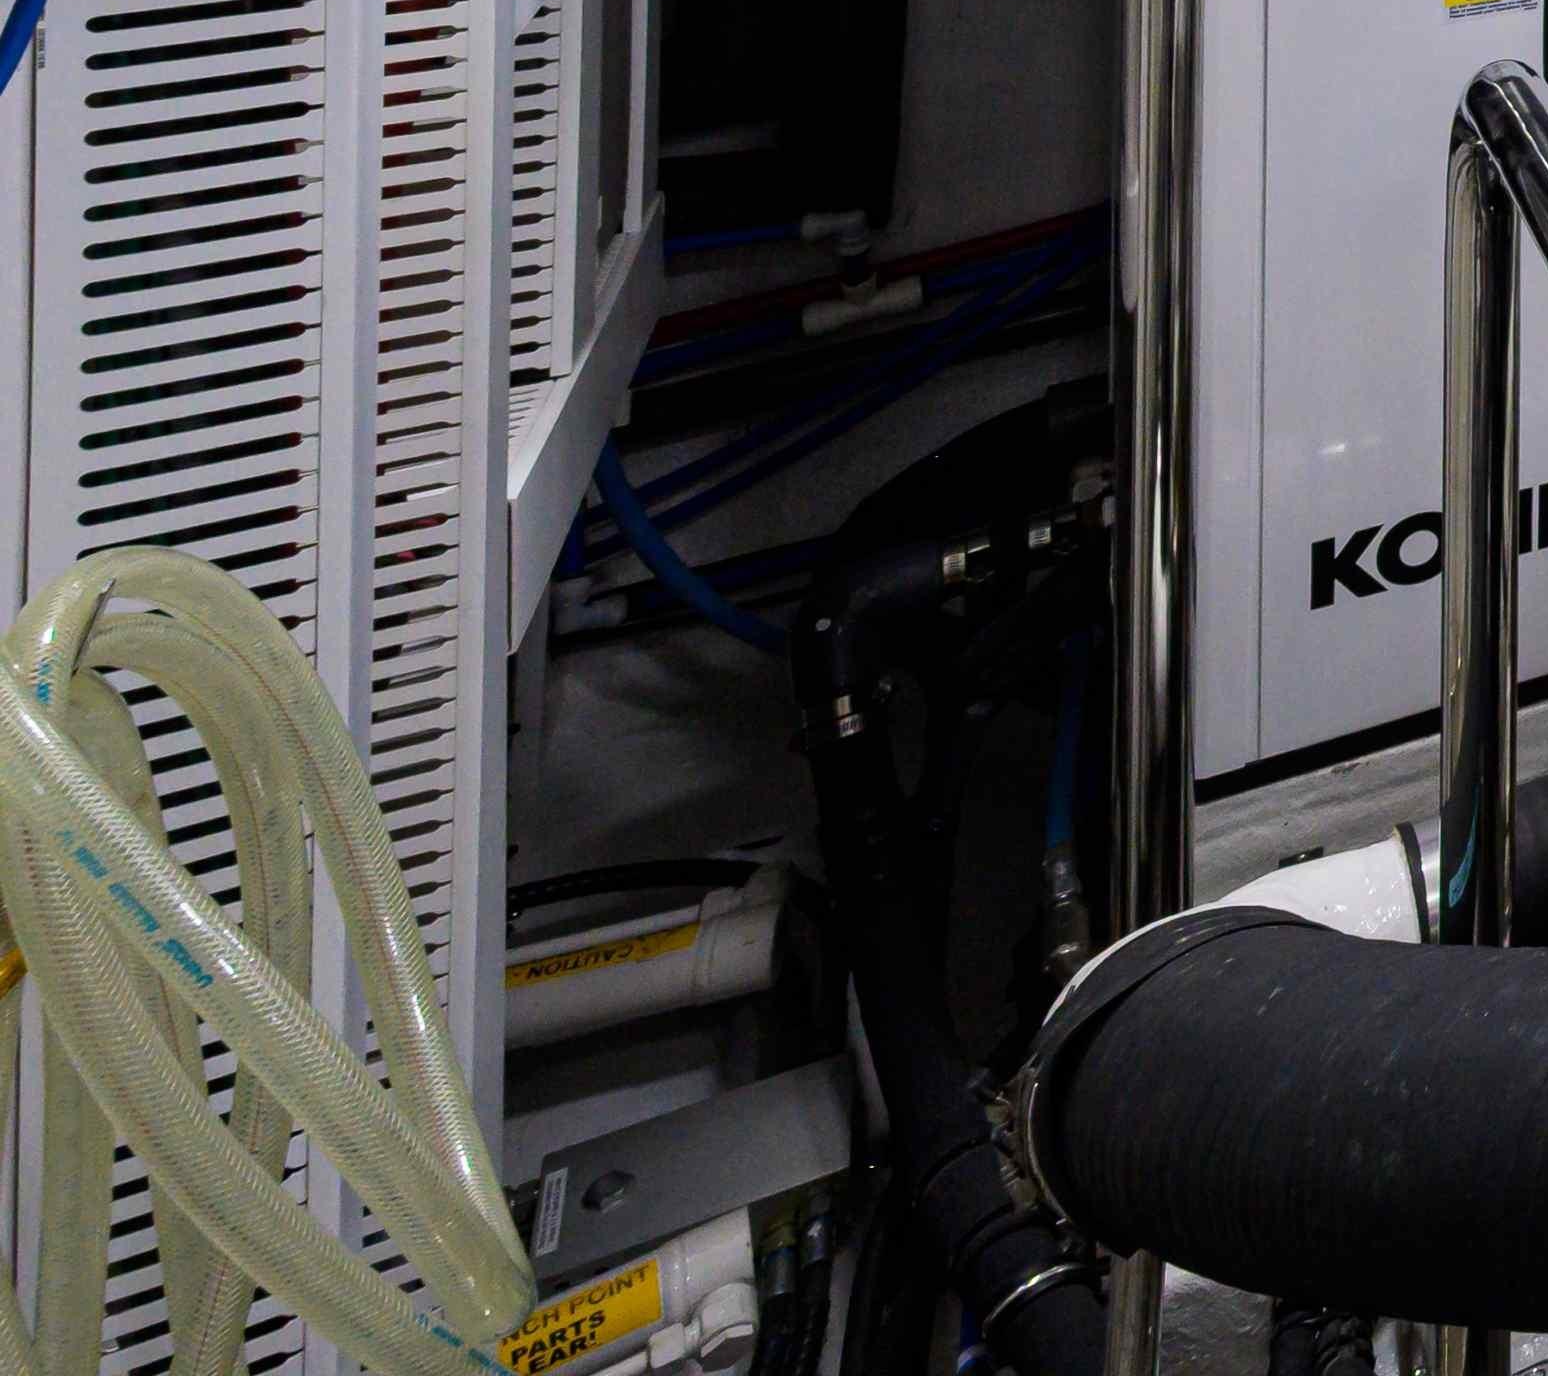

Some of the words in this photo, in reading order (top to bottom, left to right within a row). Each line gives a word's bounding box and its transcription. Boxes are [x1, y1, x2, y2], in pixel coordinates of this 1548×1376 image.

[526, 943, 634, 979] CAUTION
[568, 1264, 650, 1315] POINT
[510, 1310, 606, 1366] PARTS
